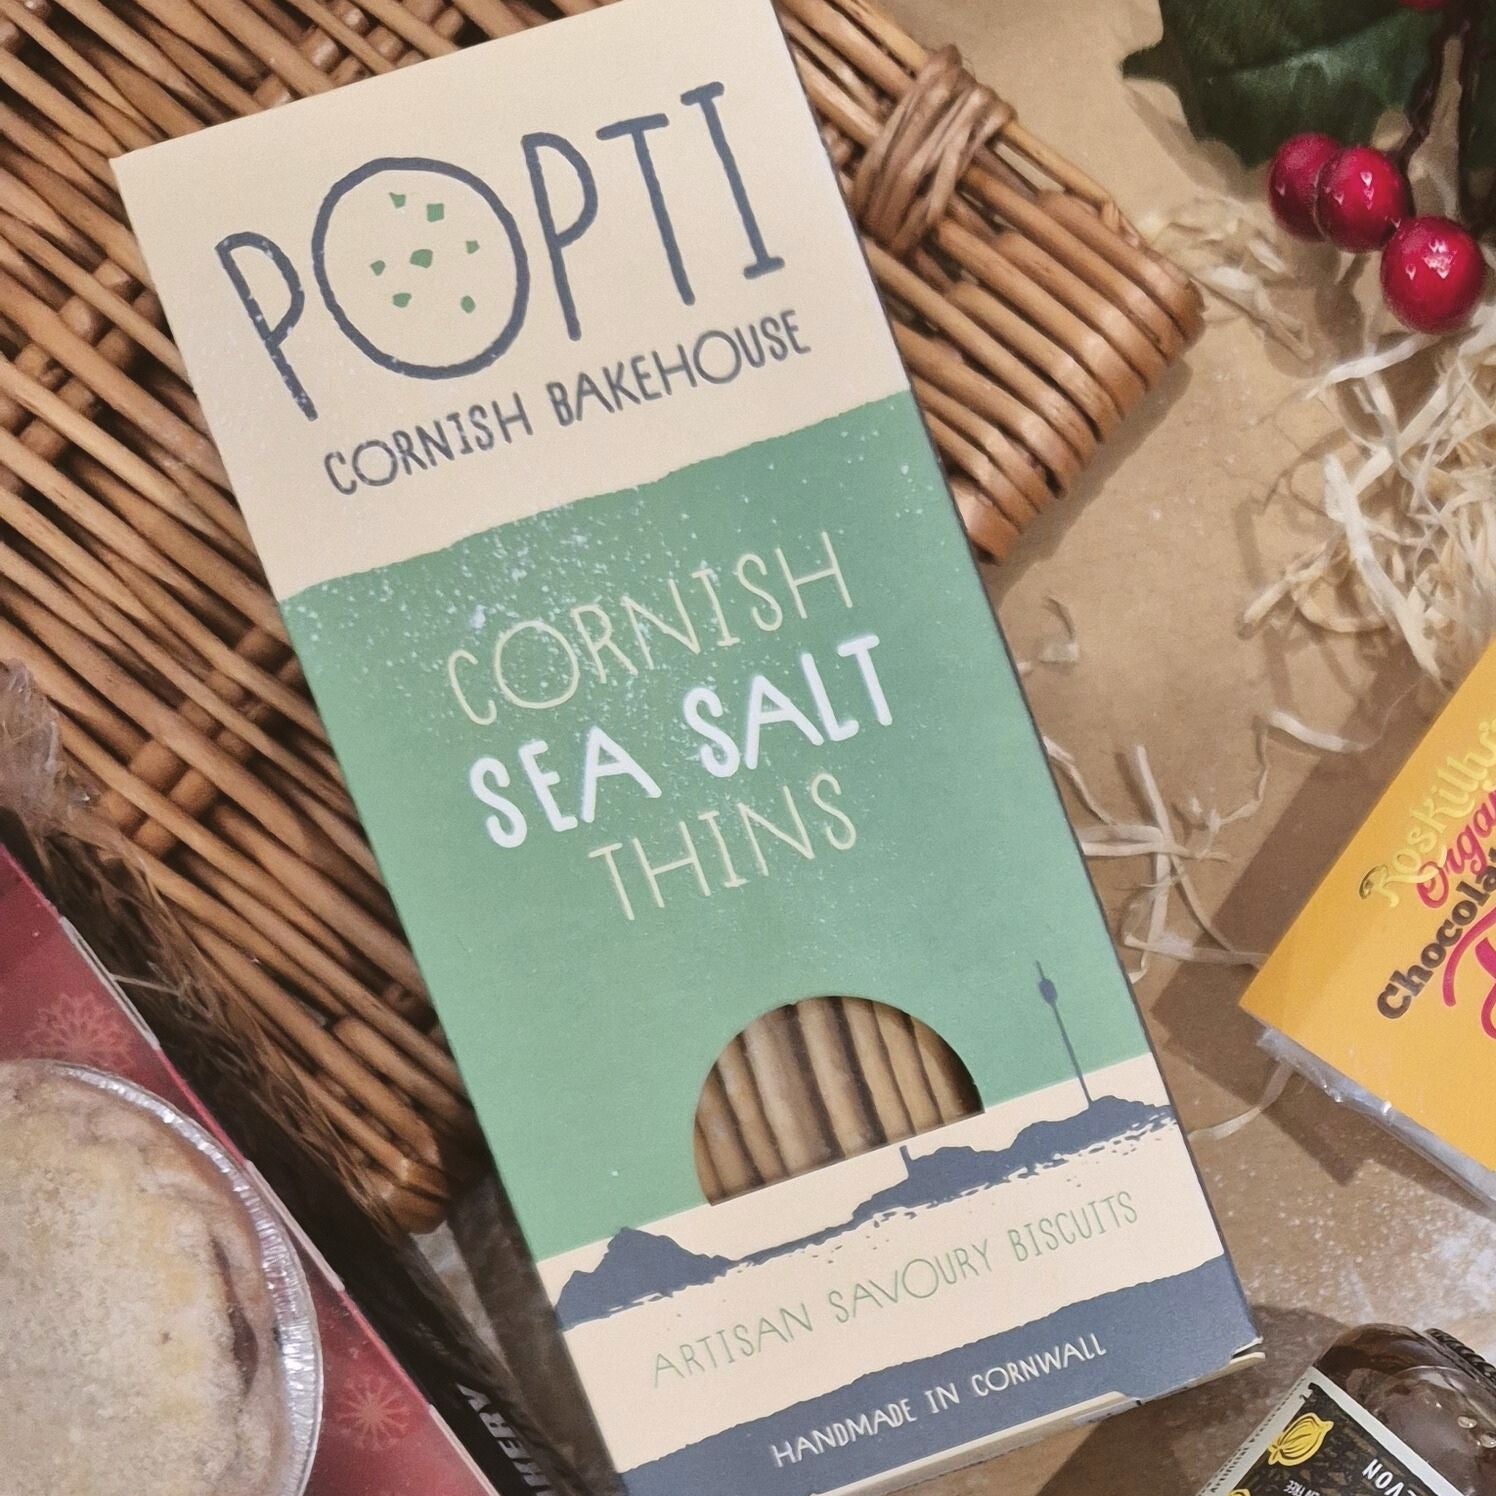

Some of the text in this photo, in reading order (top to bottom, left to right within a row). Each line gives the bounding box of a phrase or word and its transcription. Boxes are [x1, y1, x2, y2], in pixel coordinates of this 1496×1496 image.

[215, 81, 786, 421] POPTI
[324, 310, 811, 495] CORNISH BAKEHOUSE
[448, 532, 854, 725] CORNISH
[469, 635, 892, 848] SEA SALT
[588, 773, 856, 920] THINS
[654, 1190, 1139, 1389] ARTISAN SAVOURY BISCUITS
[771, 1333, 1107, 1467] HANDMADE IN CORNWALL
